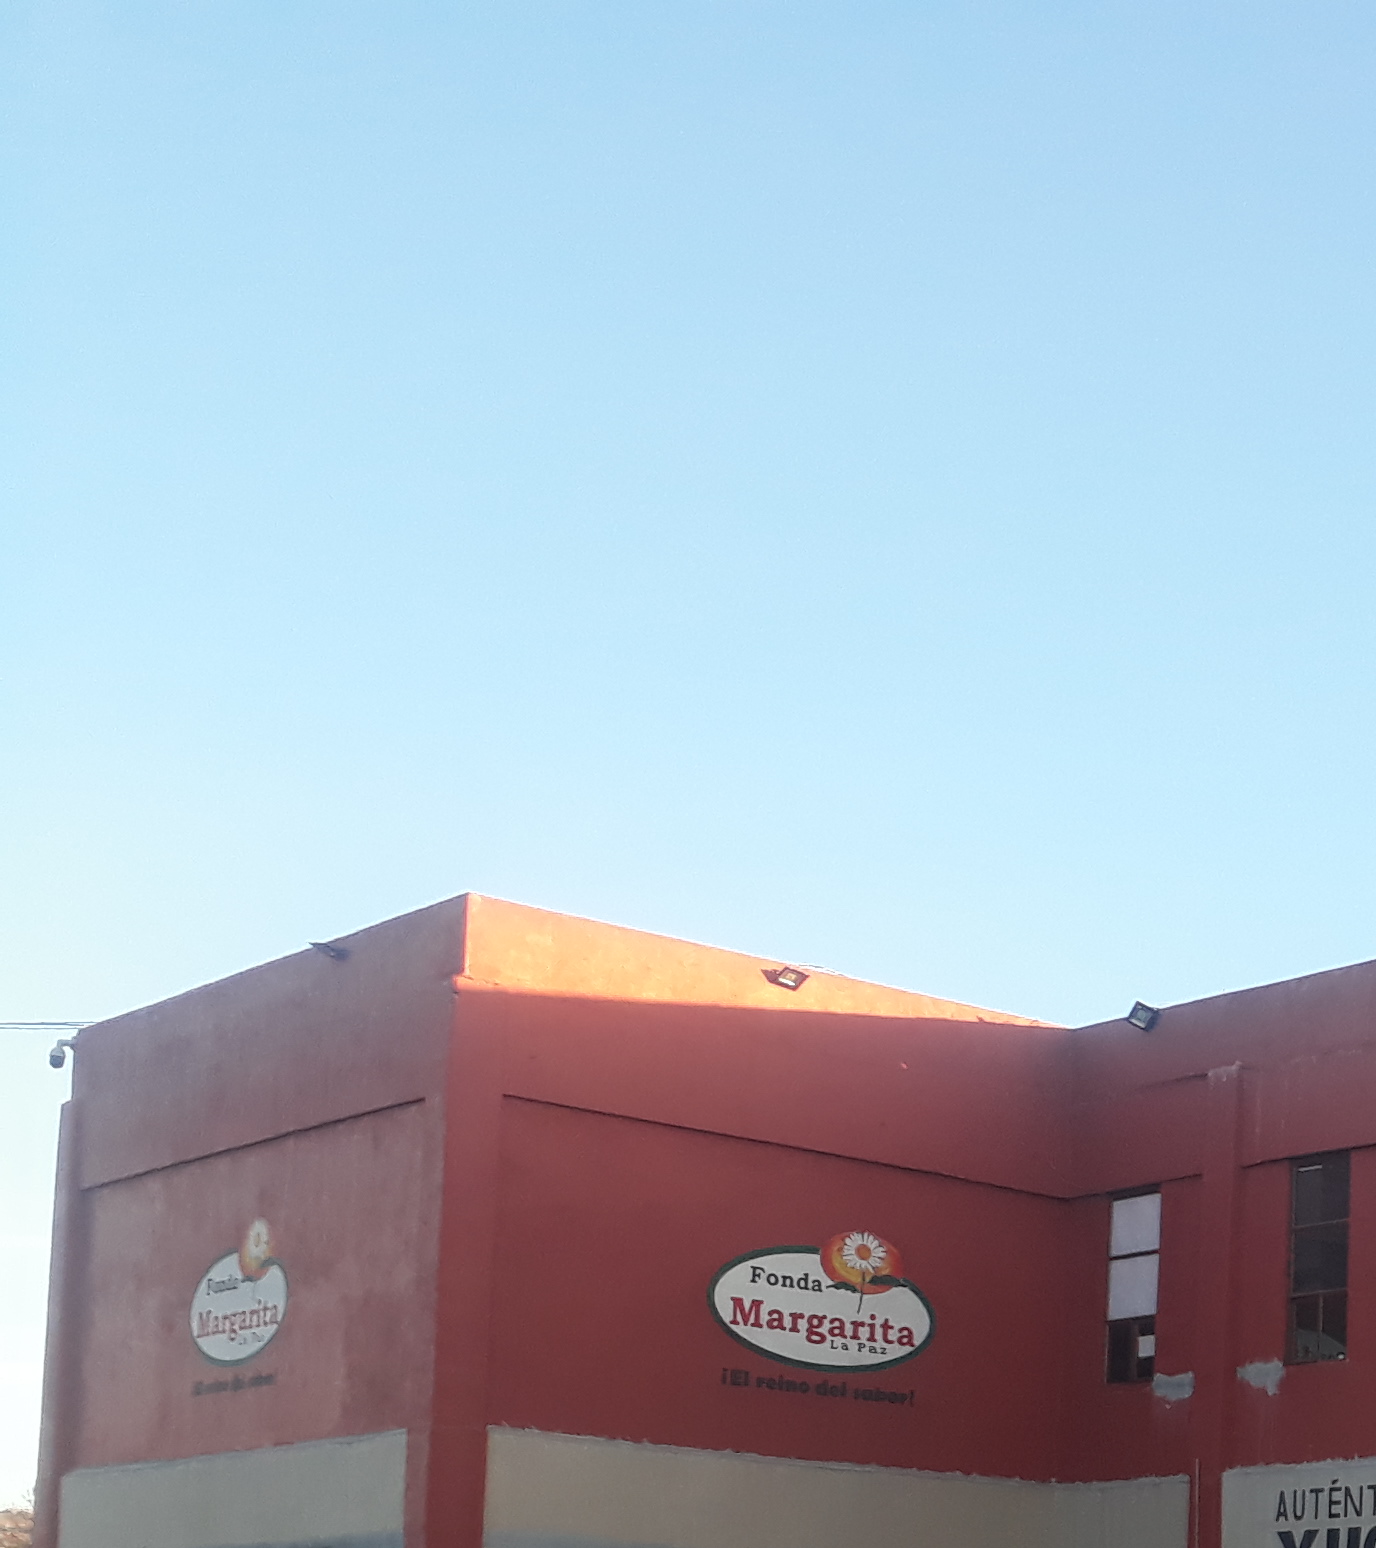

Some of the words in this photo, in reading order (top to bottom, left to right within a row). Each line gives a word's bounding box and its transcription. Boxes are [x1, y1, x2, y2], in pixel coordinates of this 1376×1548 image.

[750, 1265, 823, 1293] Fonda
[729, 1296, 917, 1348] Margarita
[830, 1339, 849, 1351] La
[857, 1342, 888, 1355] Paz
